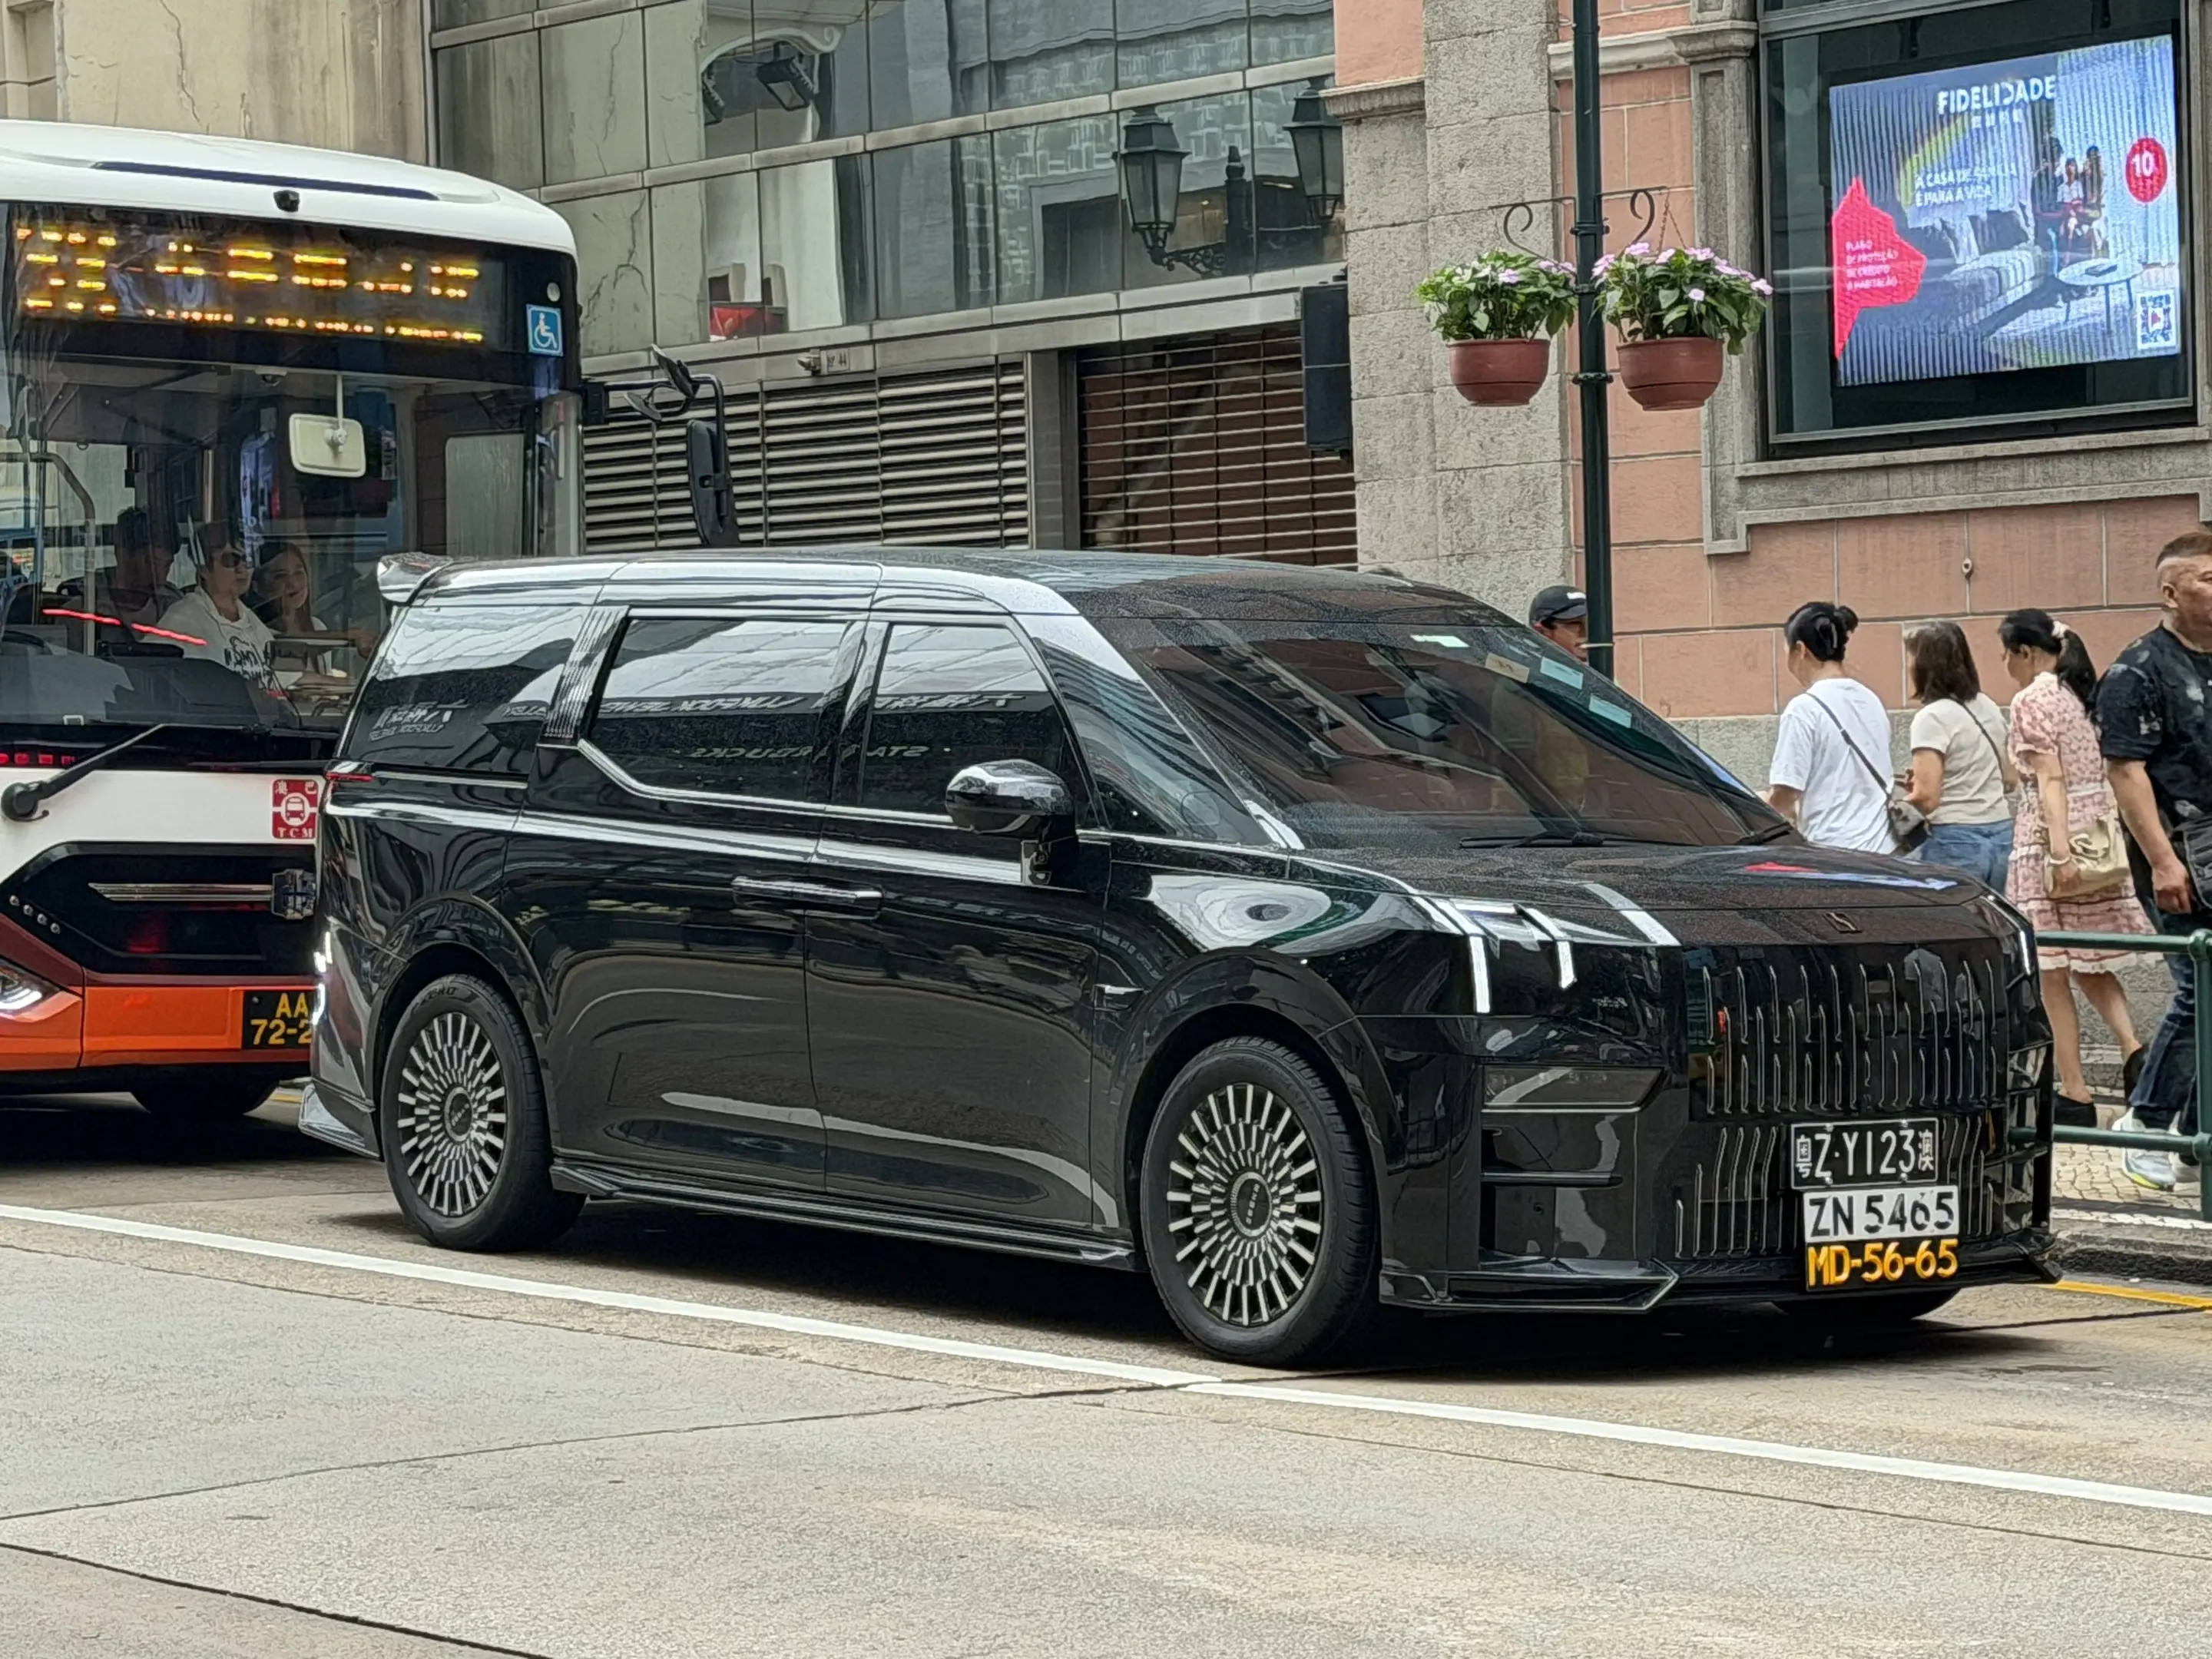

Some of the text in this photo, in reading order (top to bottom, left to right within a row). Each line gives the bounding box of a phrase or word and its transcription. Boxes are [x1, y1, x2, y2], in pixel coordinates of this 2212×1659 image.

[1936, 75, 2057, 115] FIDELIDADE
[275, 992, 309, 1018] AA
[1809, 1195, 1854, 1238] ZN
[1808, 1238, 1958, 1287] MD-56-65
